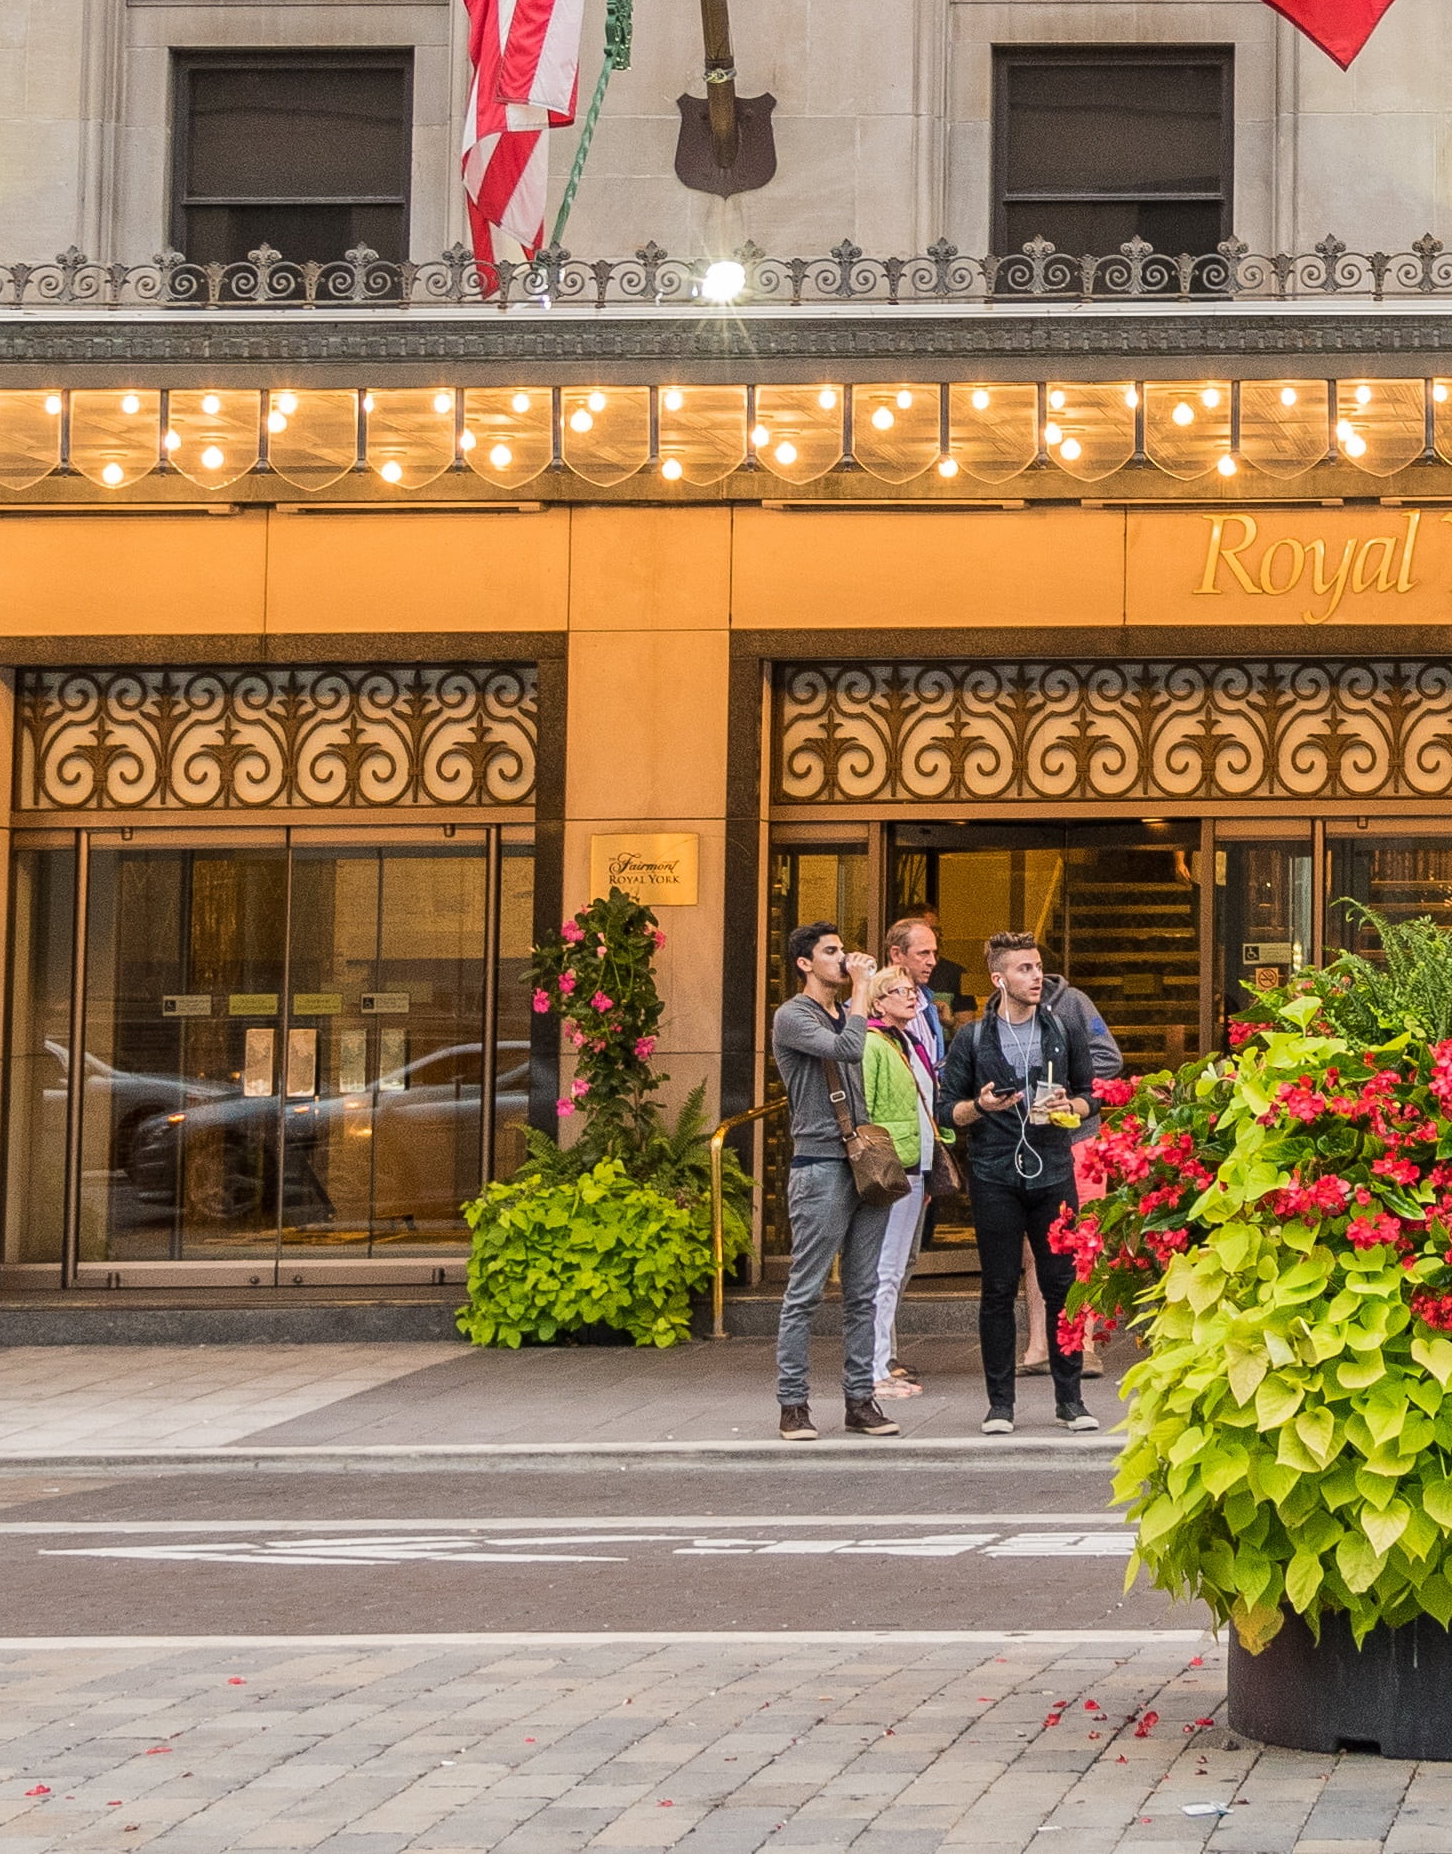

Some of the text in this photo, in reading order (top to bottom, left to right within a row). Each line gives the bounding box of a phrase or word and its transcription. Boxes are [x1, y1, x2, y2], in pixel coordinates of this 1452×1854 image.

[1193, 508, 1422, 625] Royal
[609, 852, 680, 875] Fairmont
[609, 874, 681, 885] ROYAL YORK
